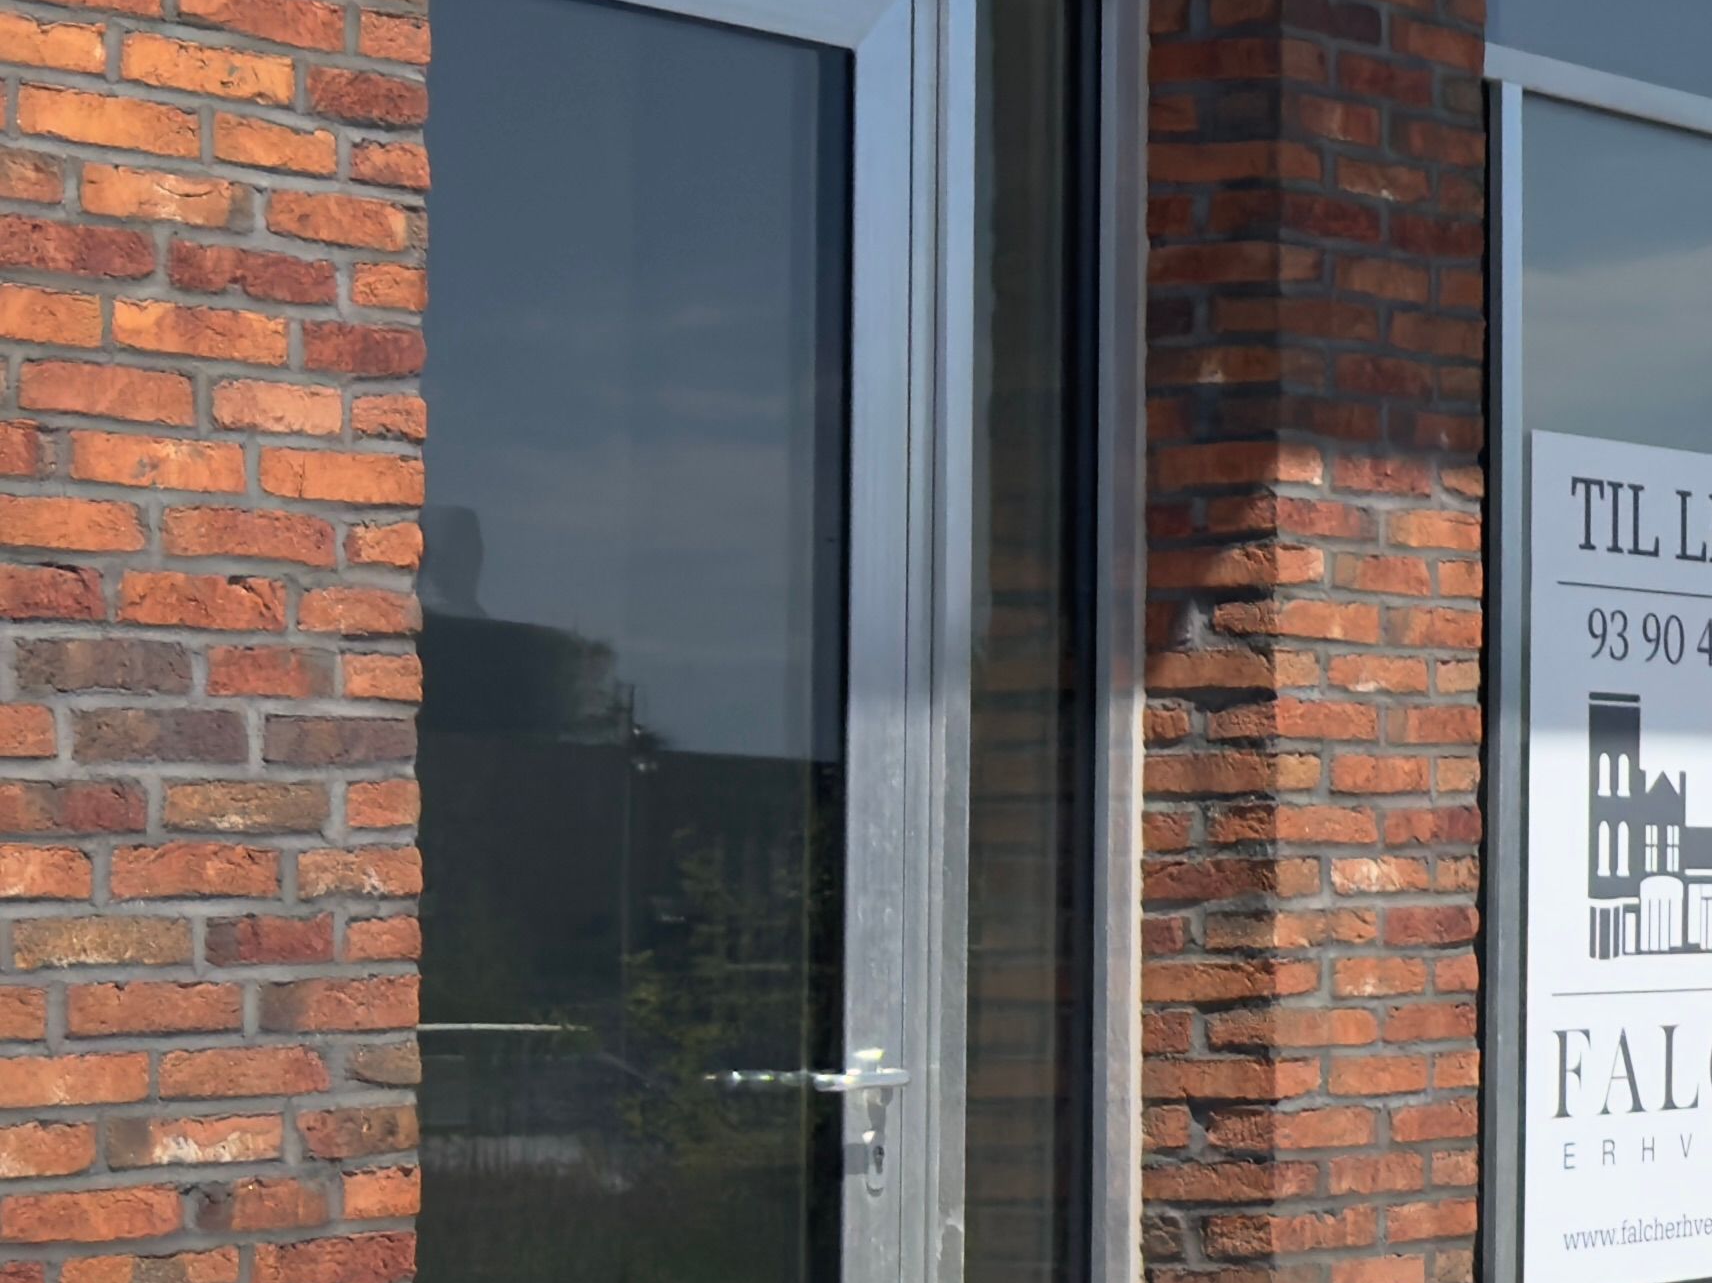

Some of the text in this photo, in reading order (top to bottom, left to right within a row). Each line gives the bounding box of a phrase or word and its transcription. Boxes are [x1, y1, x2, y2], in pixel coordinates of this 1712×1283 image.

[1571, 476, 1660, 558] TIL
[1587, 607, 1629, 662] 93
[1642, 612, 1685, 666] 90
